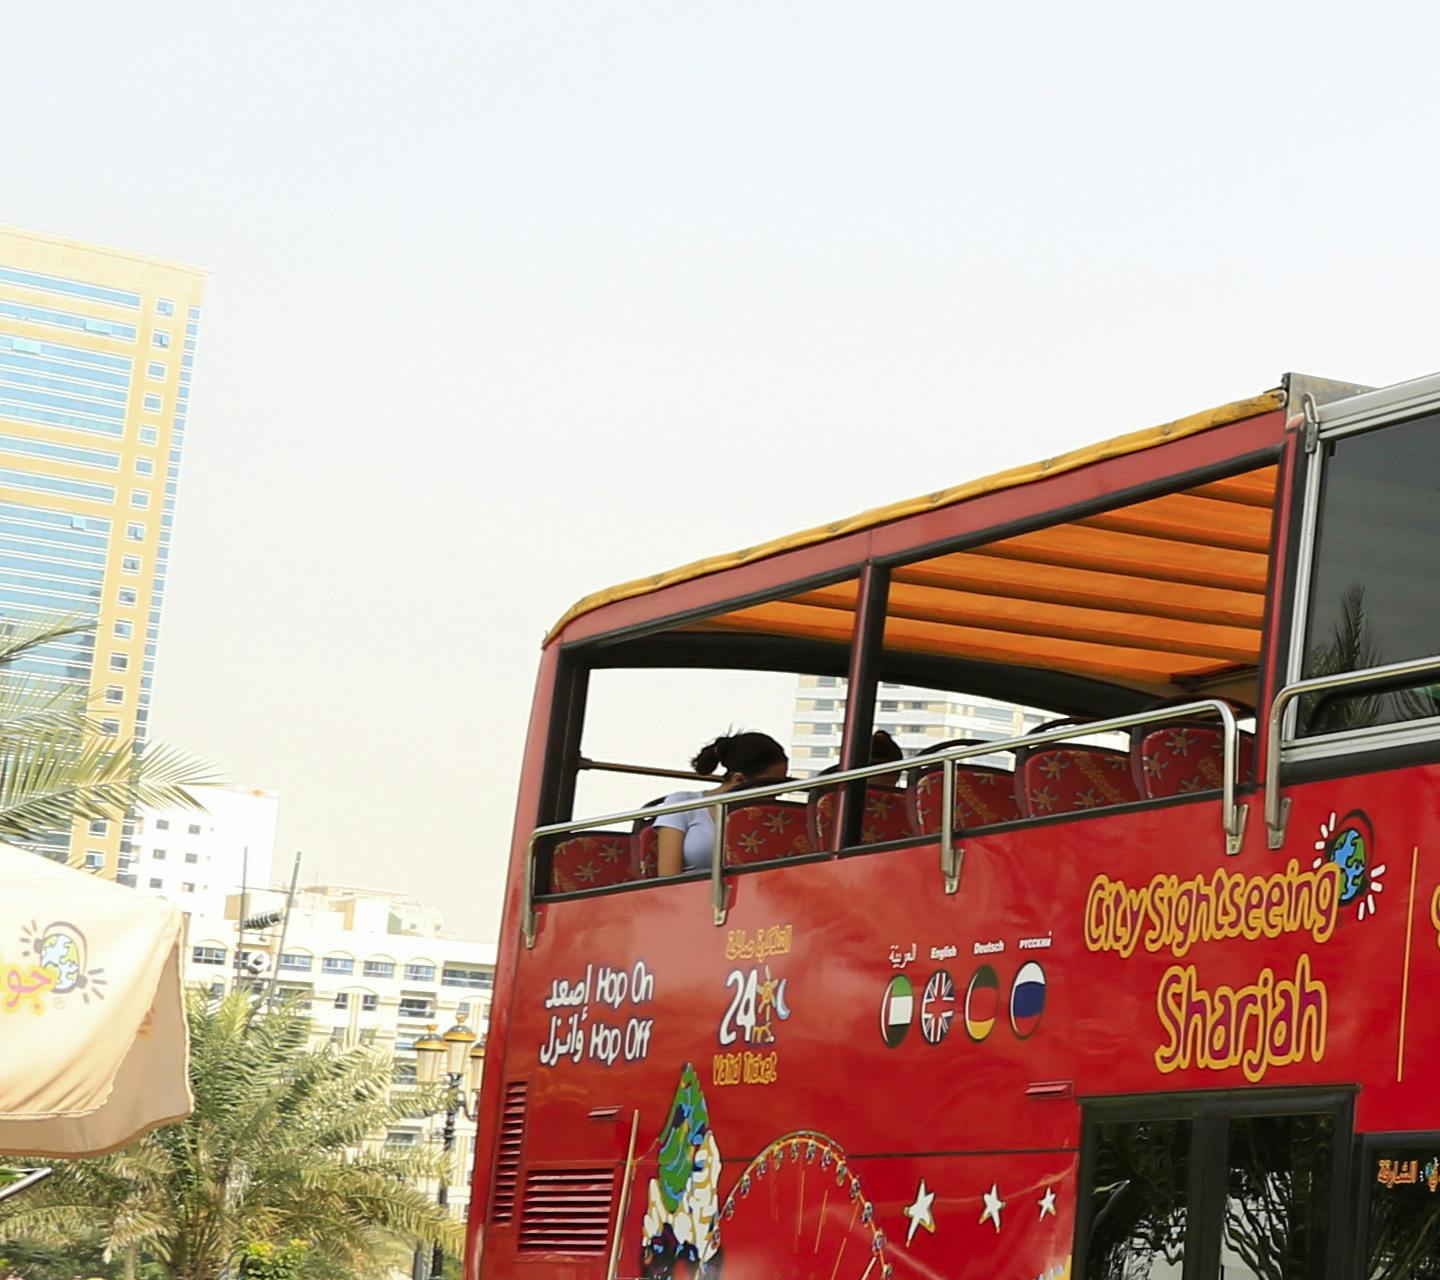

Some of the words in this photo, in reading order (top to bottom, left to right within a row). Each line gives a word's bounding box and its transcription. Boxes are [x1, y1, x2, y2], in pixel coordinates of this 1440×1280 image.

[596, 967, 628, 1009] Hop
[631, 961, 654, 1003] On
[1155, 953, 1328, 1082] Sharjah
[589, 1023, 621, 1066] Hop
[625, 1018, 653, 1060] Off
